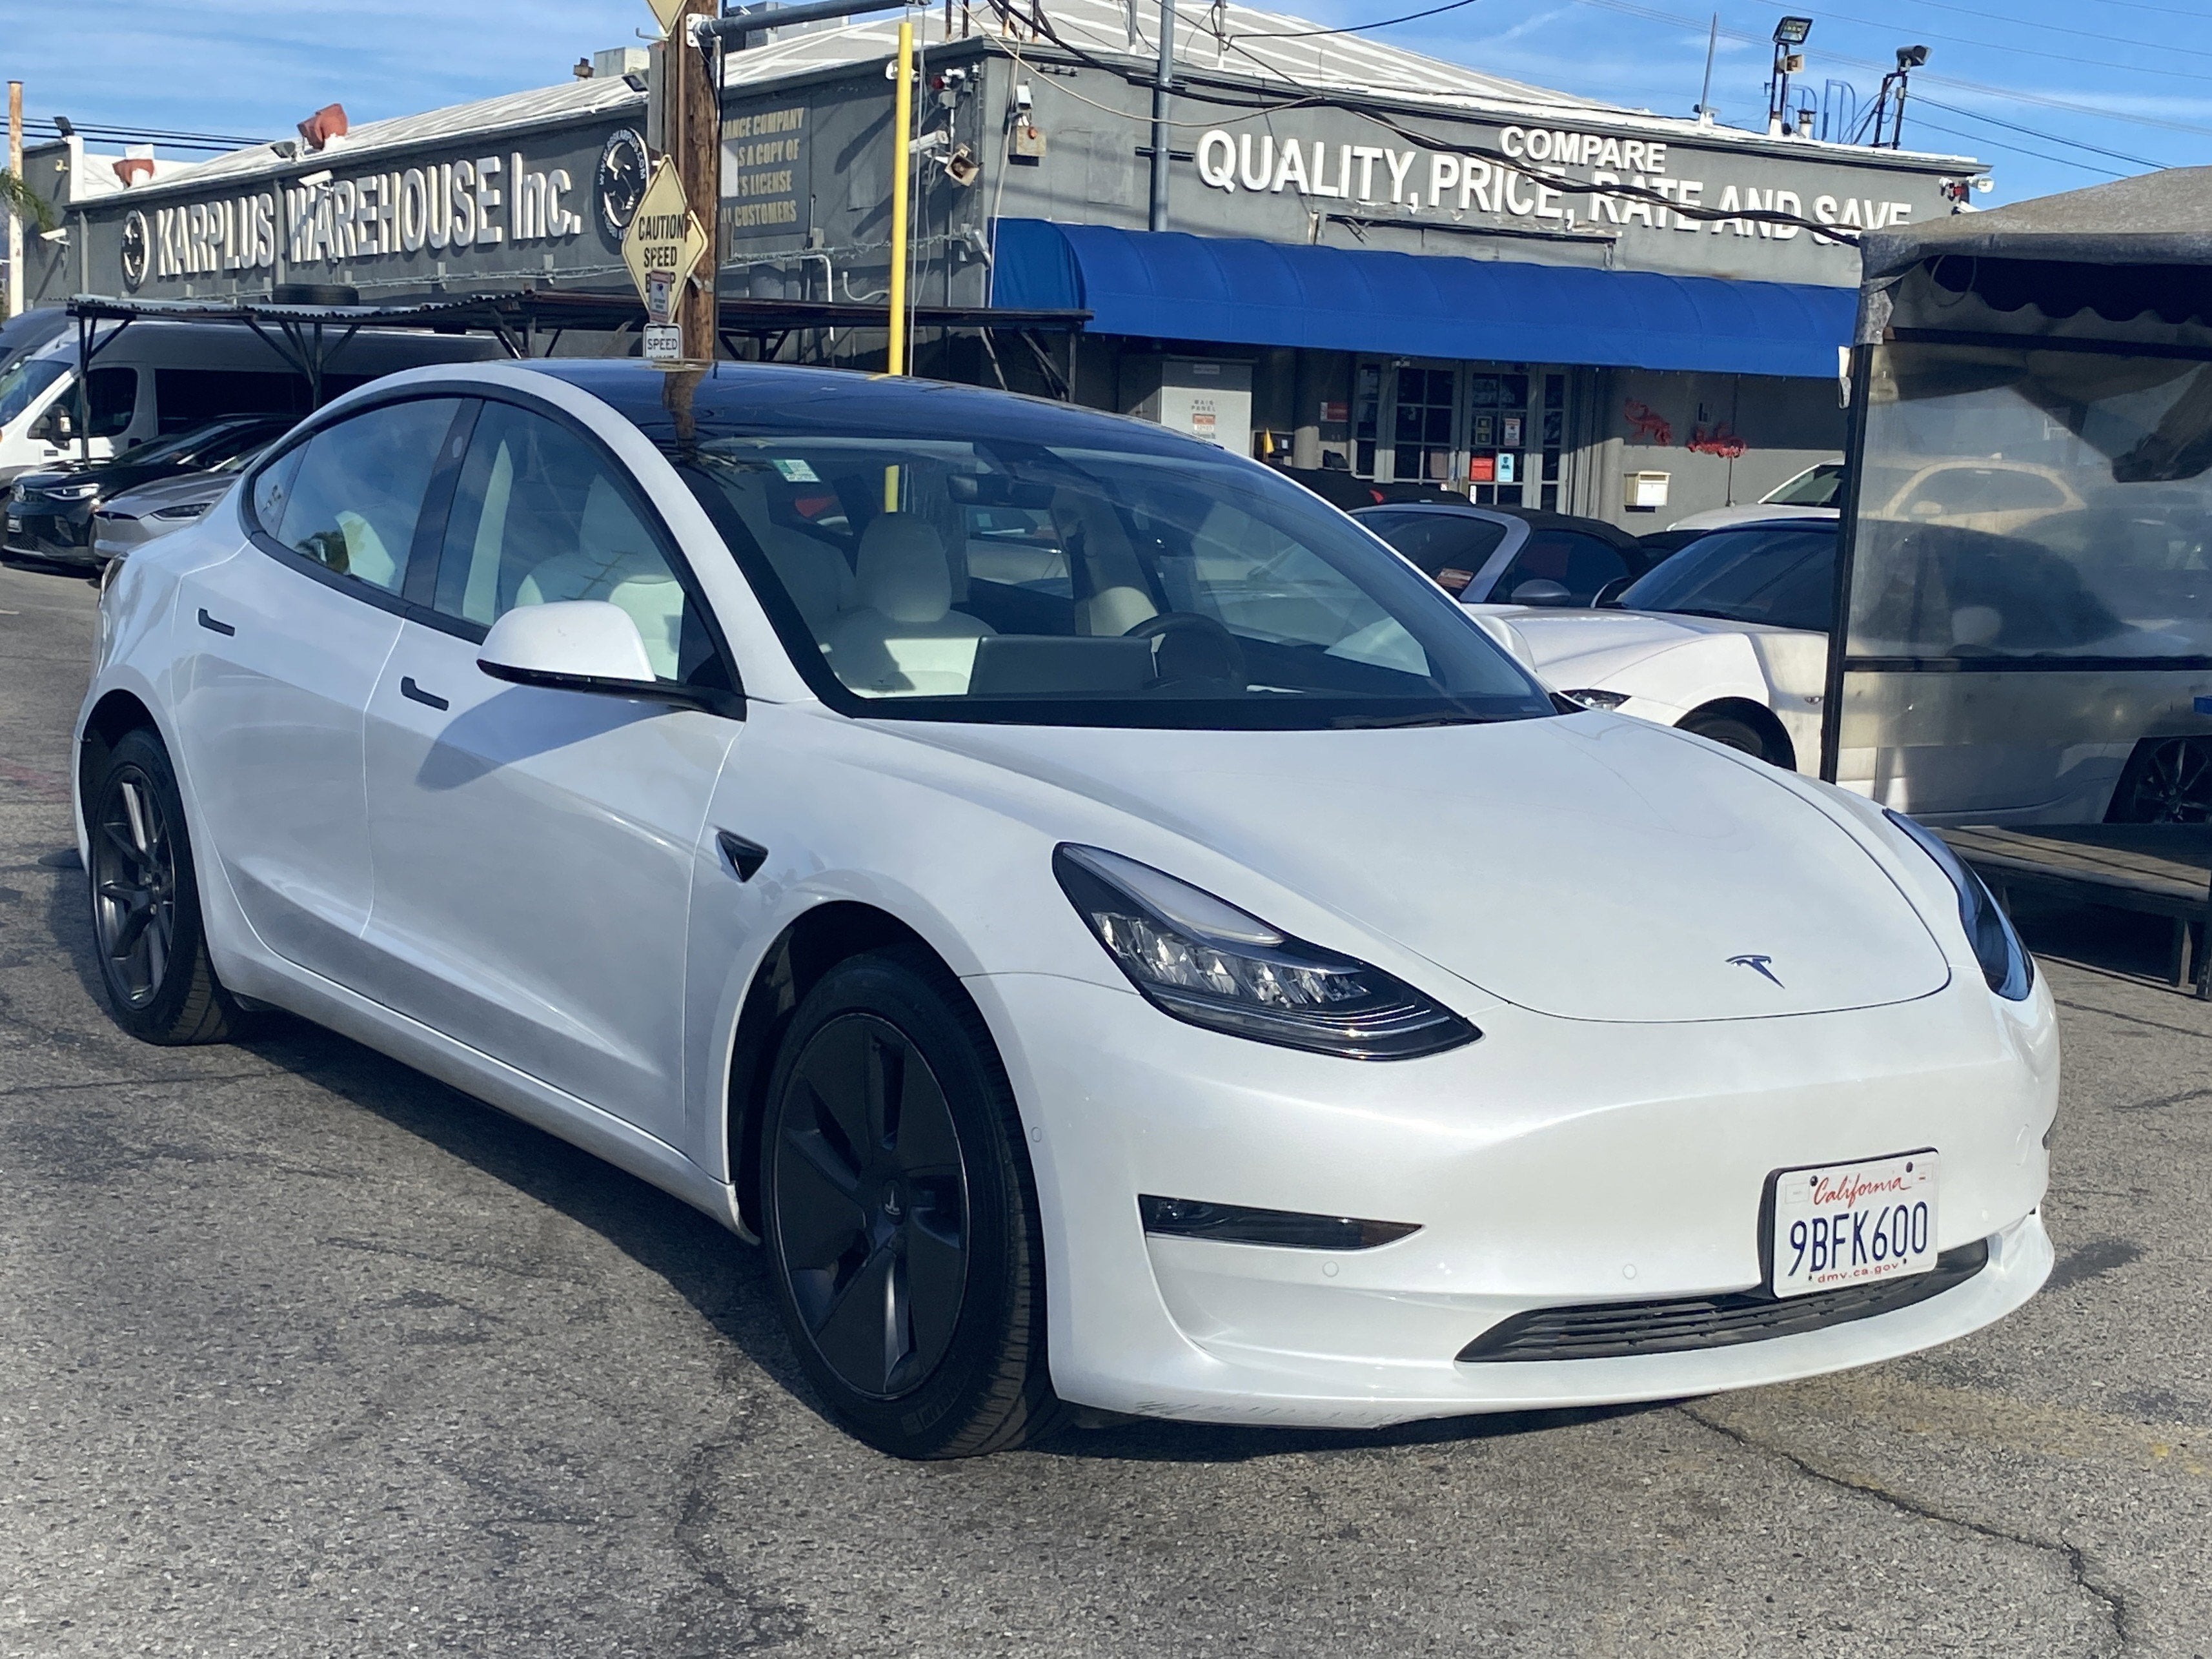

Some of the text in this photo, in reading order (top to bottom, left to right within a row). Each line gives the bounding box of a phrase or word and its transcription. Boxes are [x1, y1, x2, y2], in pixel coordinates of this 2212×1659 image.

[753, 107, 804, 136] COMPANY
[746, 145, 755, 167] A
[756, 140, 784, 165] COPY
[786, 137, 800, 161] OF
[1498, 125, 1667, 173] COMPARE
[750, 170, 793, 196] LICENSE
[1197, 129, 1913, 245] QUALITY, PRICE, RATE AND SAVE
[156, 193, 274, 276] KARPLUS
[286, 156, 502, 263] WAREHOUSE
[511, 152, 581, 240] Inc.
[638, 213, 687, 242] CAUTION
[735, 199, 797, 227] CUSTOMERS
[644, 246, 677, 268] SPEED
[647, 338, 678, 351] SPEED
[1813, 1173, 1912, 1208] California
[1788, 1201, 1927, 1277] 9BFK600
[1818, 1262, 1898, 1283] dmv.ca.gov
